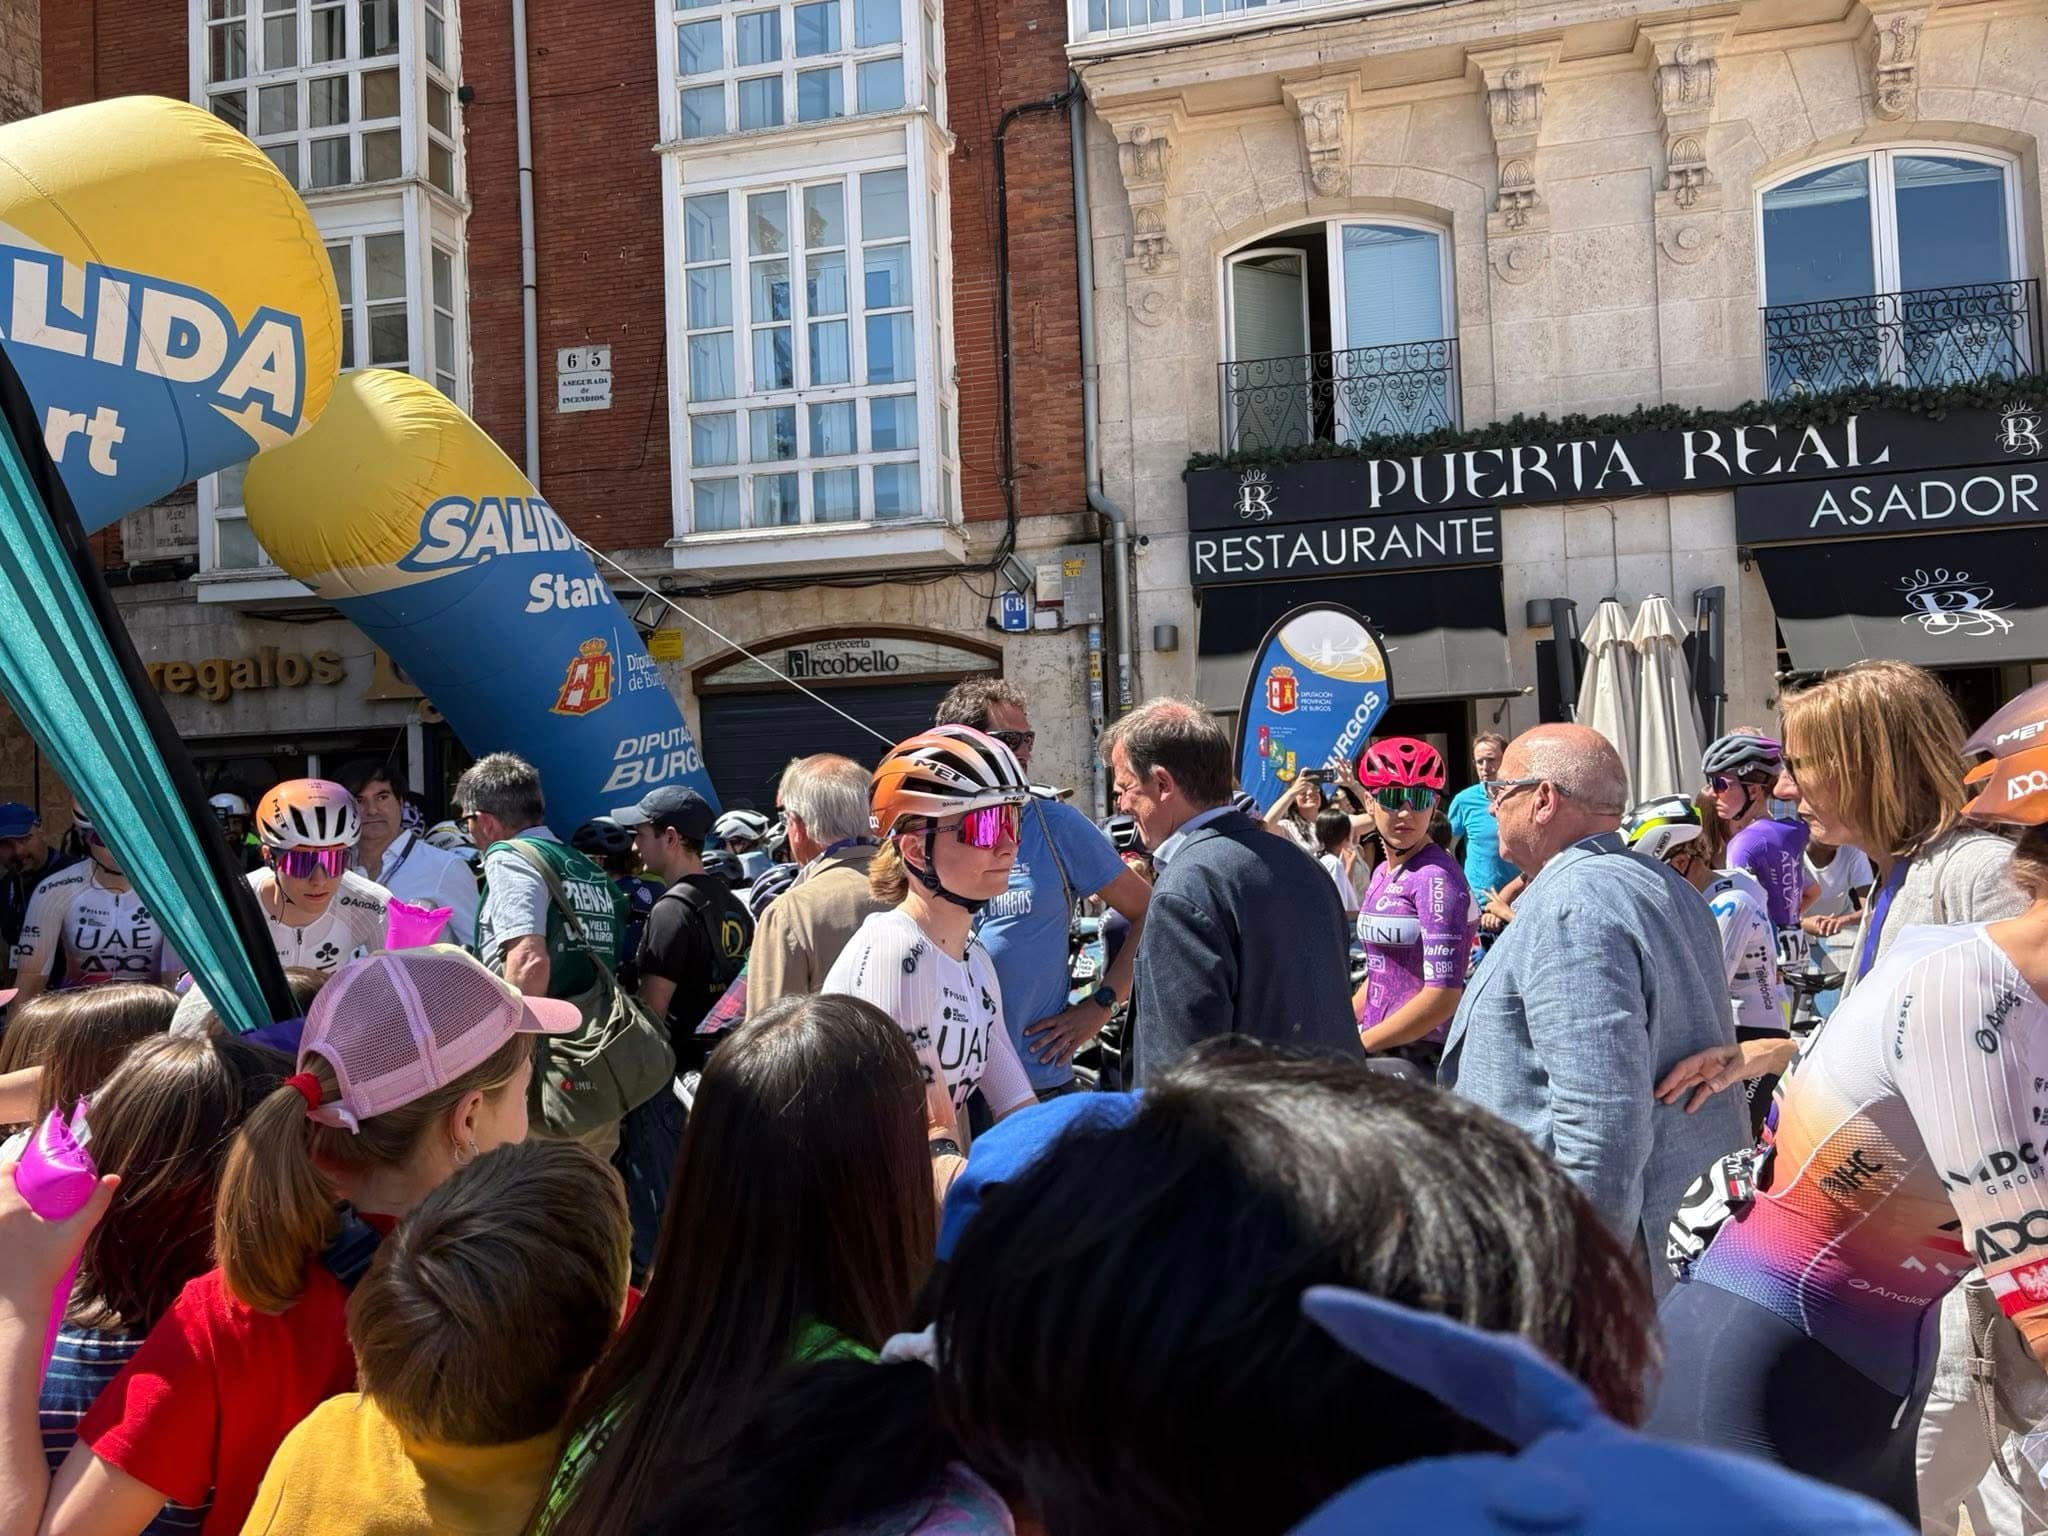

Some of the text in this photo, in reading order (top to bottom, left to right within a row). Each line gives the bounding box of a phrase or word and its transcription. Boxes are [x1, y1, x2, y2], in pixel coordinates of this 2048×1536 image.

[0, 257, 296, 419] LIDA
[44, 405, 127, 477] rt
[1368, 415, 1891, 509] PUERTA REAL
[1808, 473, 2040, 529] ASADOR
[413, 503, 580, 563] SALID
[1195, 516, 1495, 575] RESTAURANTE
[525, 573, 610, 613] Start
[1004, 596, 1025, 612] CB
[147, 646, 349, 702] regalos
[788, 649, 899, 677] Arcobello
[913, 759, 967, 783] MET
[351, 898, 387, 915] Analog
[561, 880, 615, 915] PRENSA
[989, 889, 1033, 917] BURGOS
[75, 926, 153, 951] UAE
